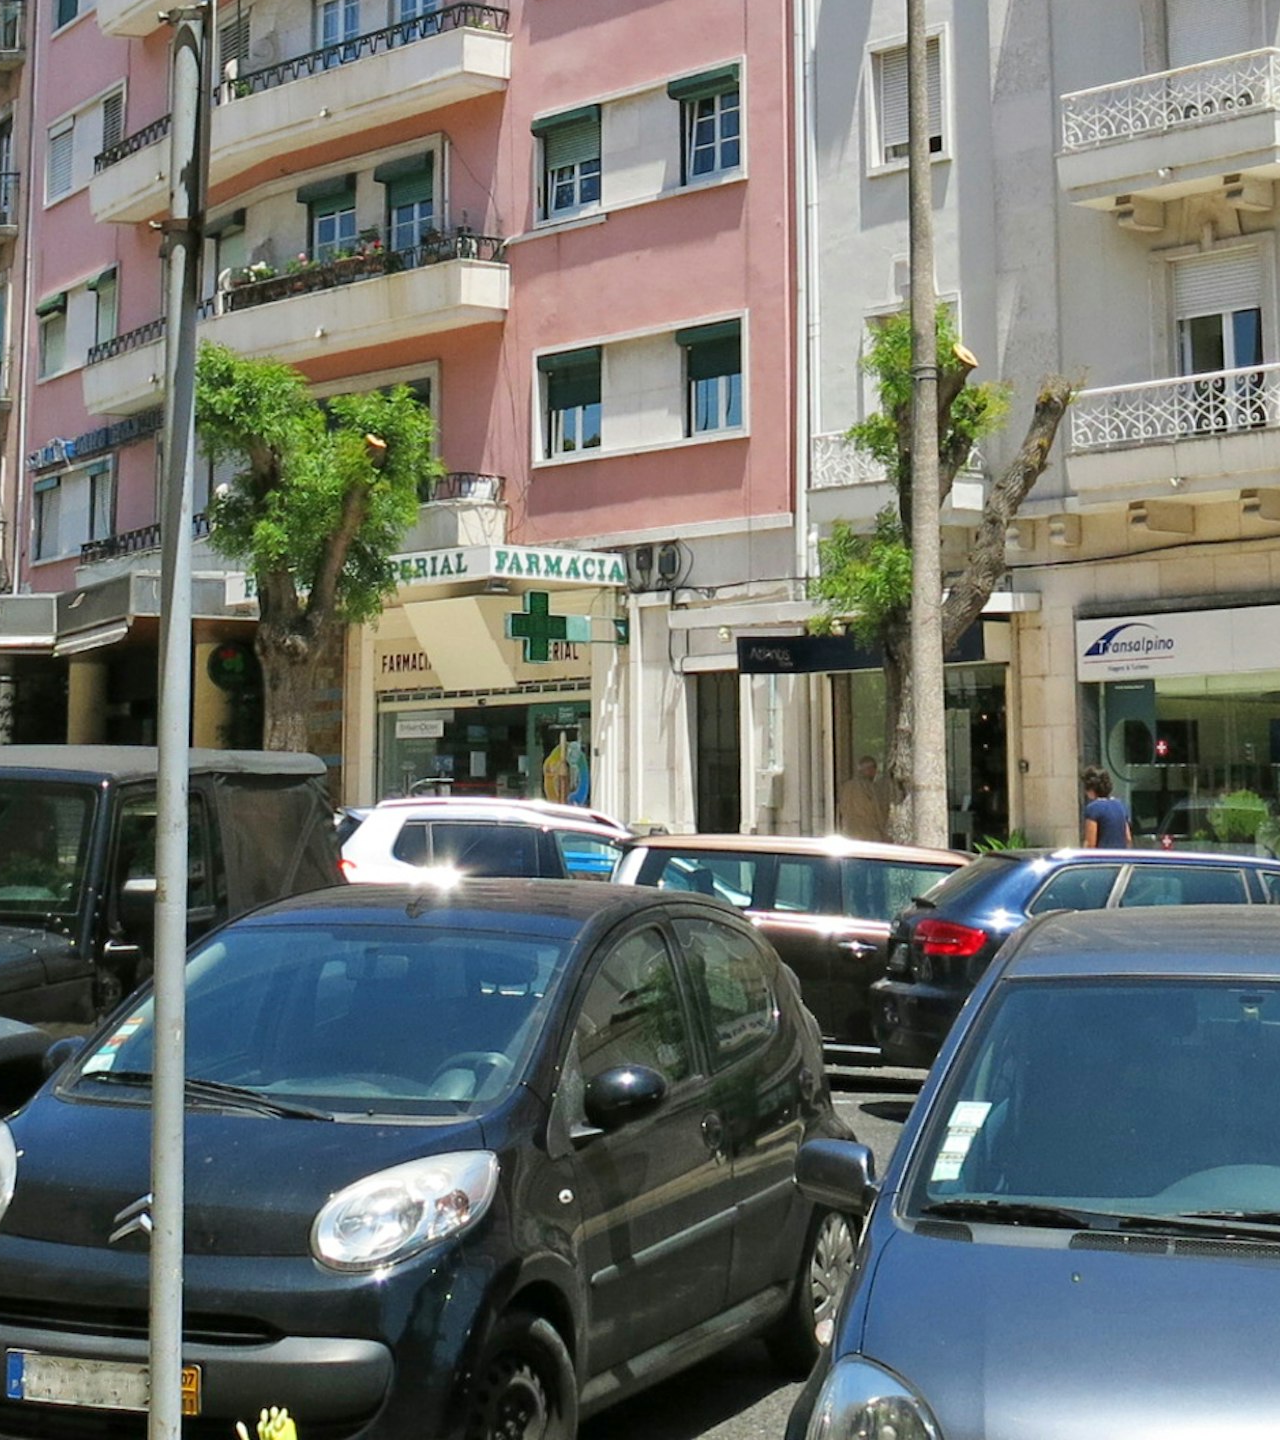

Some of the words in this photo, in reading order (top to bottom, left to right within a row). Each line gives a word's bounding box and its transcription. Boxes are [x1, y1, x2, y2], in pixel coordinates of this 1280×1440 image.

[387, 553, 468, 581] PERIAL
[1097, 636, 1174, 654] Transalpino
[381, 652, 432, 674] FARMACI
